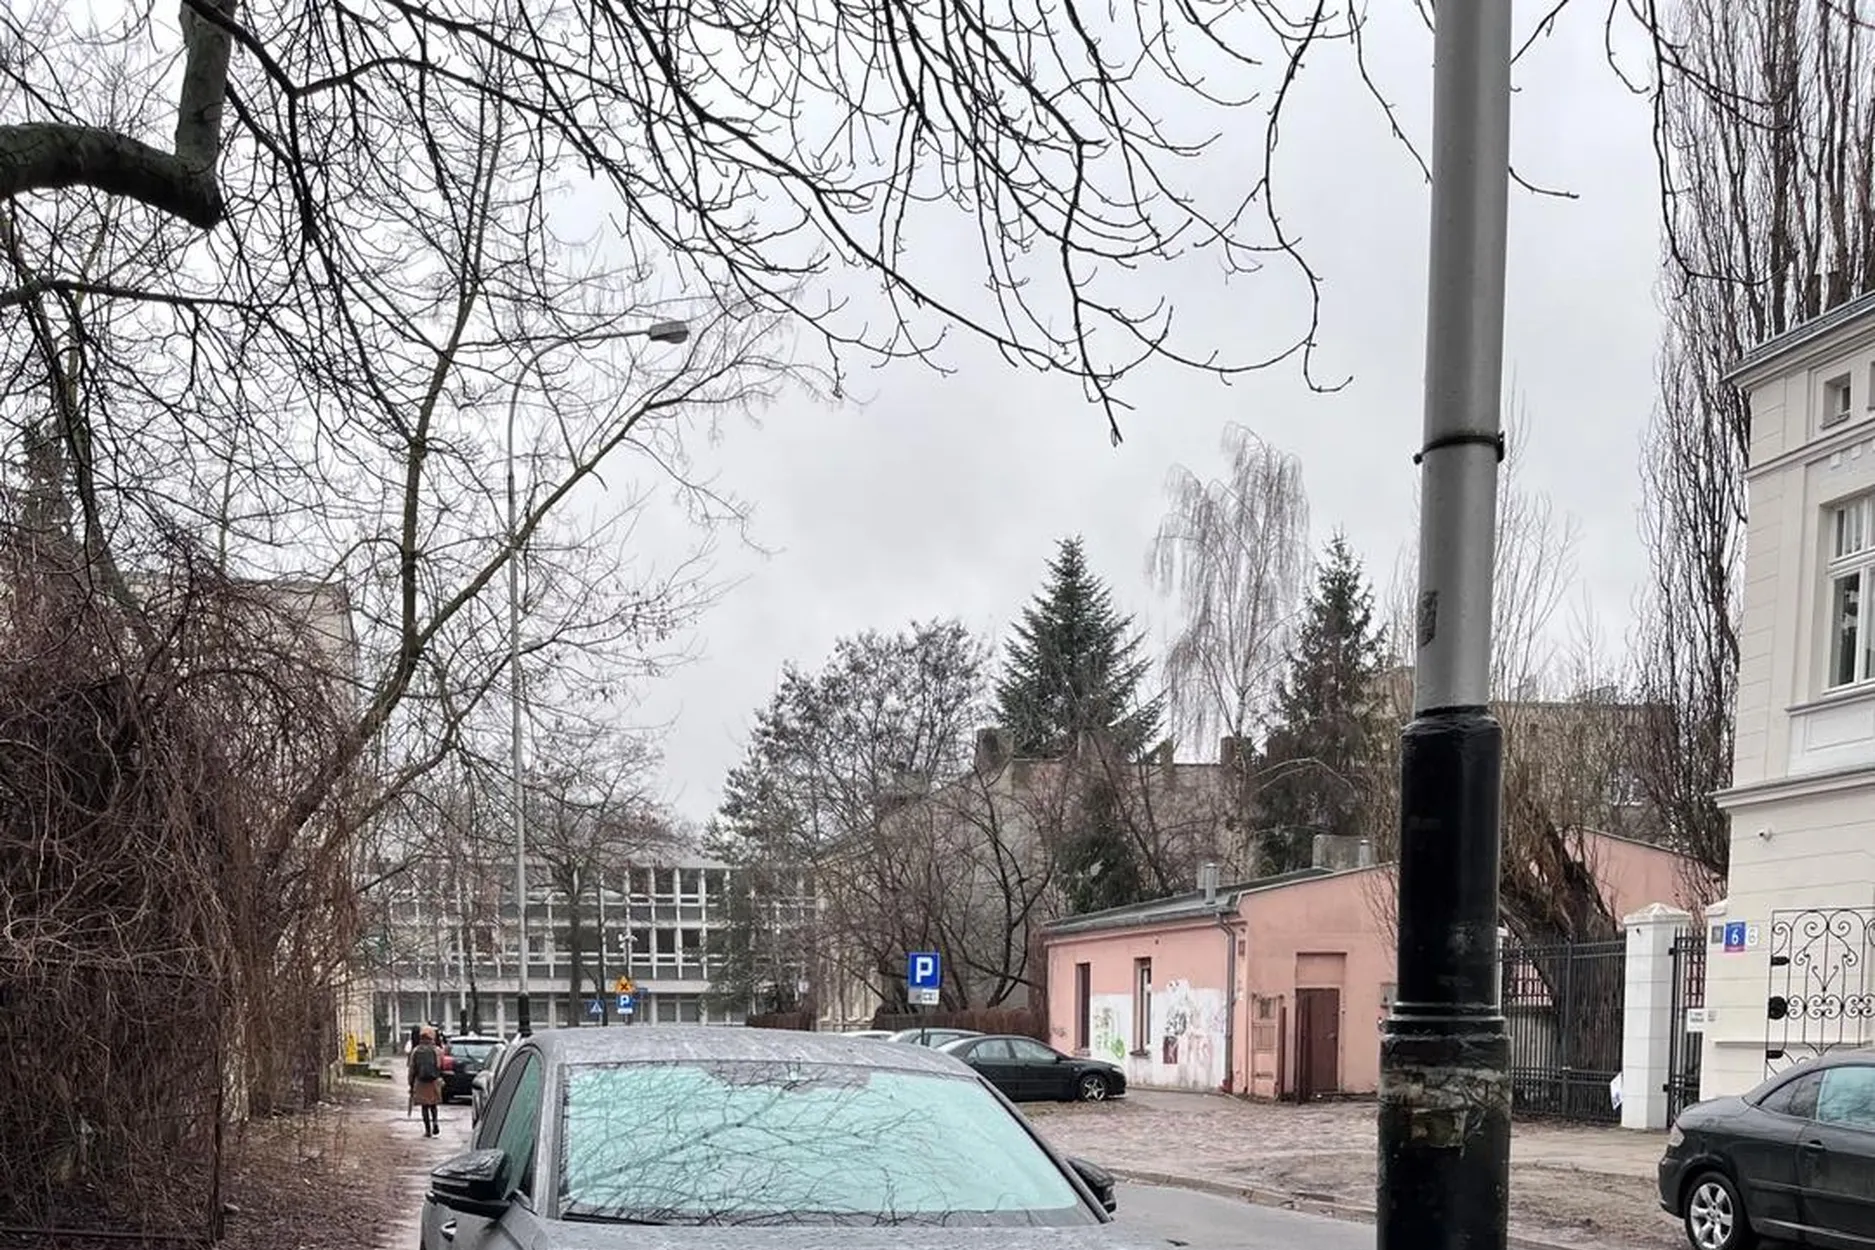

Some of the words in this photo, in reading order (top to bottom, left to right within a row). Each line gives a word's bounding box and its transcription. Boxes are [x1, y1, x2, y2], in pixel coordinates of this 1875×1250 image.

[1732, 928, 1739, 945] 6
[916, 956, 933, 983] P
[620, 994, 630, 1006] P
